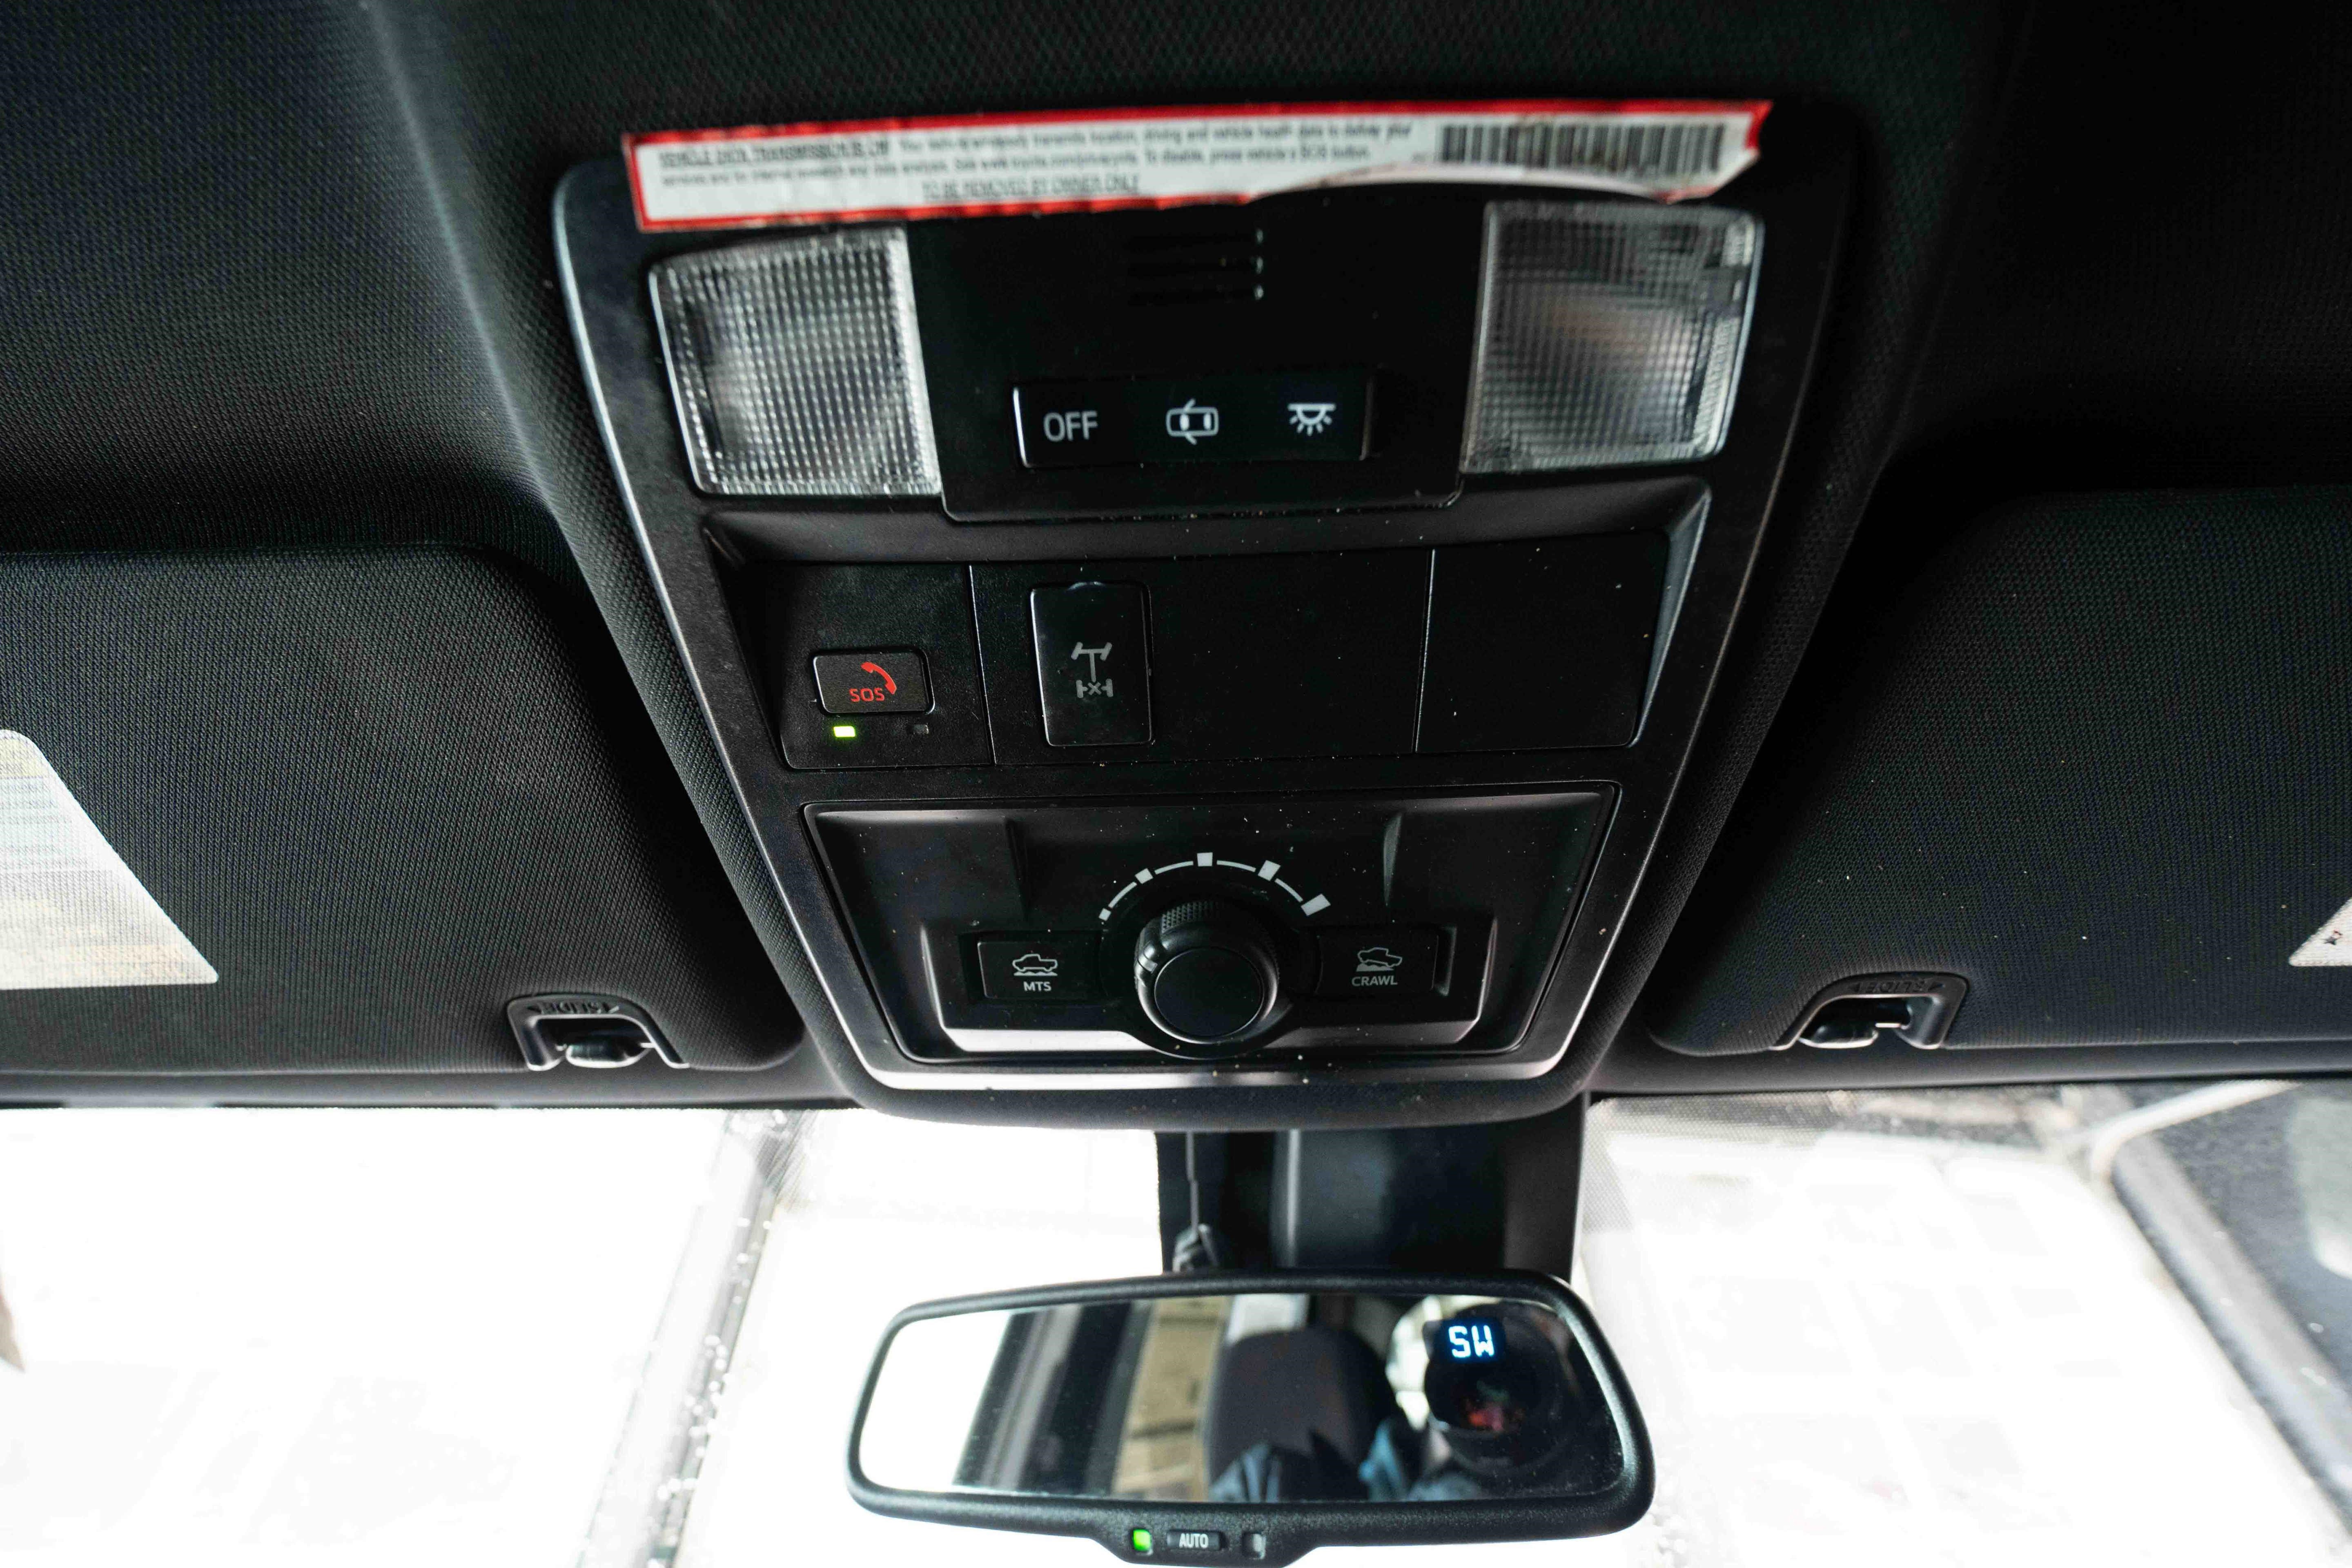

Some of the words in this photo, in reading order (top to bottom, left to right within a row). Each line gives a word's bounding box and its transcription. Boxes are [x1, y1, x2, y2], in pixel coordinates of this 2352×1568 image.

[1043, 411, 1098, 442] OFF
[849, 688, 885, 702] SOS
[1023, 981, 1052, 991] MTS
[1351, 975, 1398, 987] CRAWL
[1448, 1325, 1494, 1358] SW
[1179, 1533, 1209, 1548] AUTO
